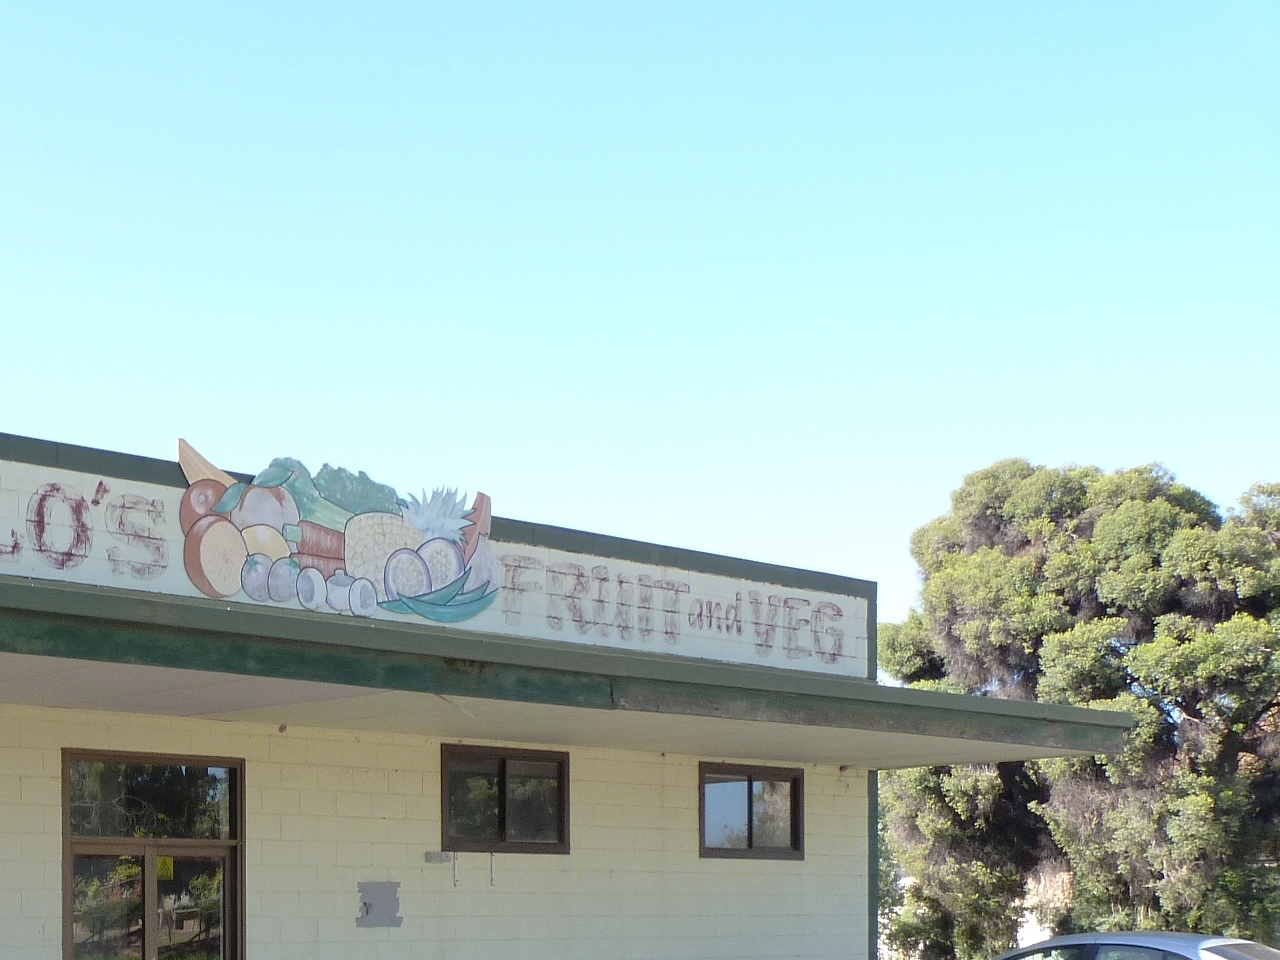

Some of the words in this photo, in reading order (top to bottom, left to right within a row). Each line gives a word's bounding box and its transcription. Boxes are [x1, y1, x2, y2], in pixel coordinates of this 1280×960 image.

[499, 554, 689, 645] FRUIT
[687, 591, 744, 637] and
[748, 589, 844, 664] VEG
